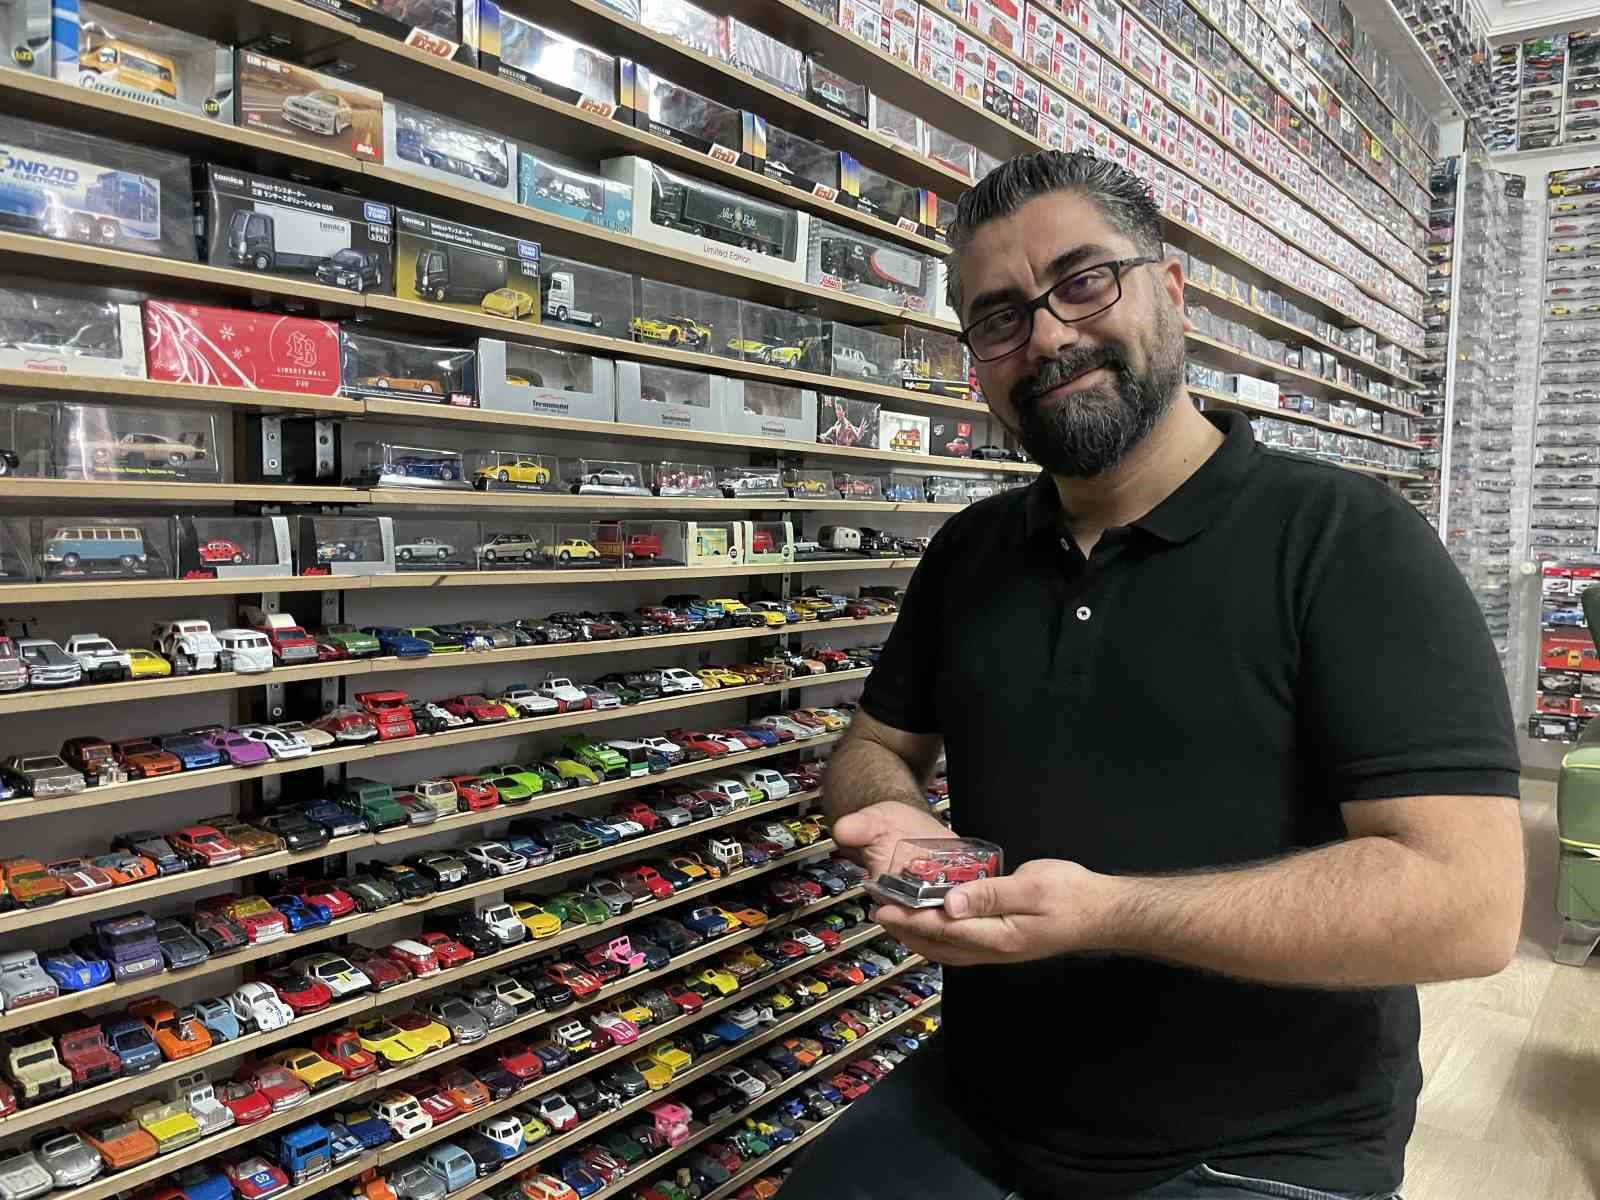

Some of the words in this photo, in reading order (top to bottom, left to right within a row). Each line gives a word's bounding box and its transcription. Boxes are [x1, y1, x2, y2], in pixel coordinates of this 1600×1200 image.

[214, 172, 244, 186] tomica
[320, 221, 346, 233] tomica
[401, 215, 425, 227] tomica
[704, 244, 728, 257] Limited
[729, 251, 753, 265] Edition
